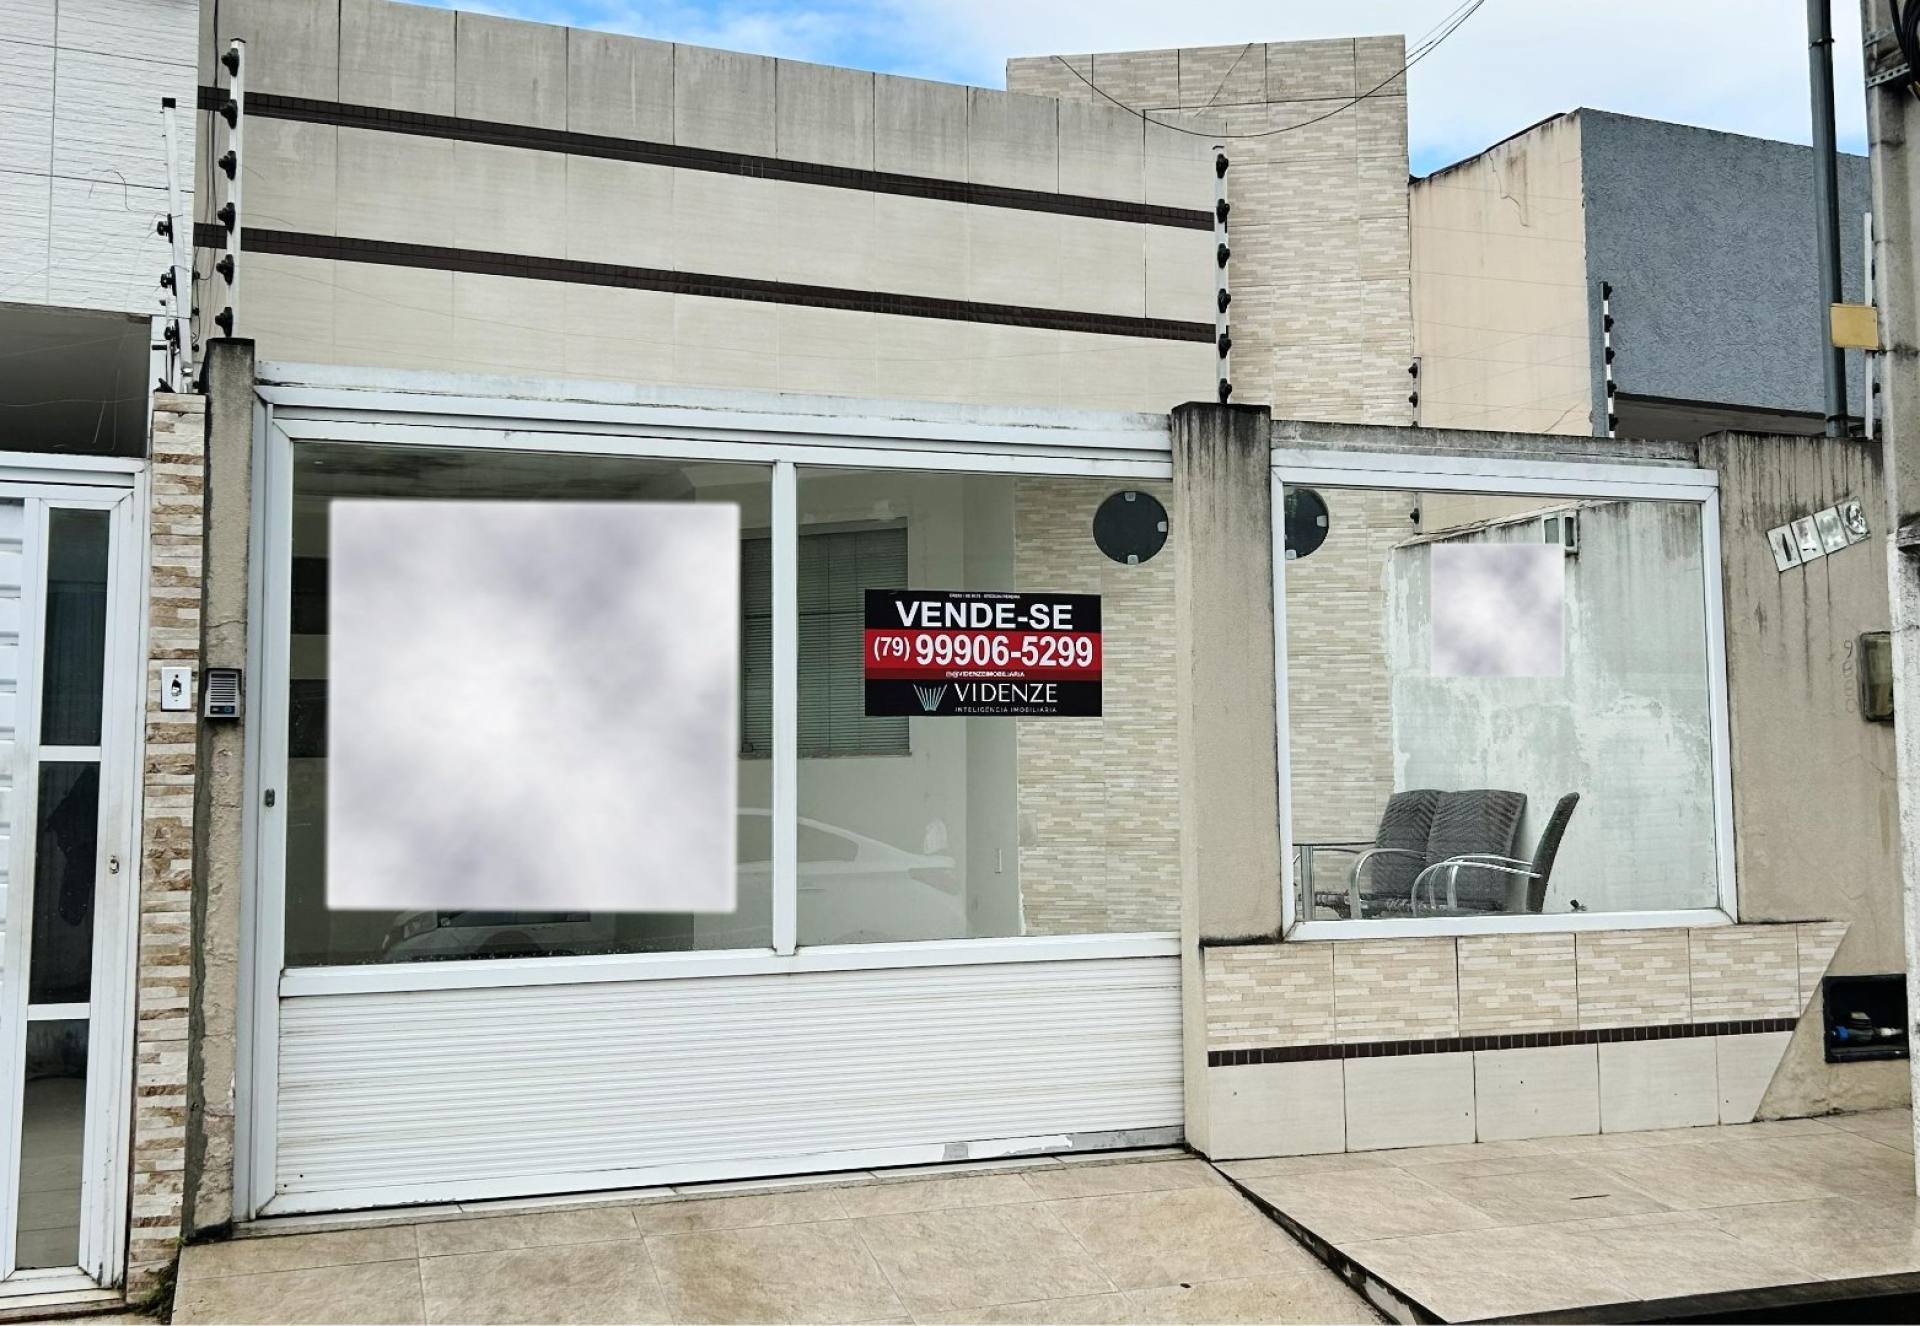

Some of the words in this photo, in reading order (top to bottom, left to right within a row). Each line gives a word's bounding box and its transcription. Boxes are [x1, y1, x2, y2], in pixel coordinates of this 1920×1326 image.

[895, 600, 1073, 630] VENDE-SE
[873, 636, 911, 662] (79)
[915, 634, 1093, 668] 99906-5299
[954, 683, 1058, 703] VIDENZE
